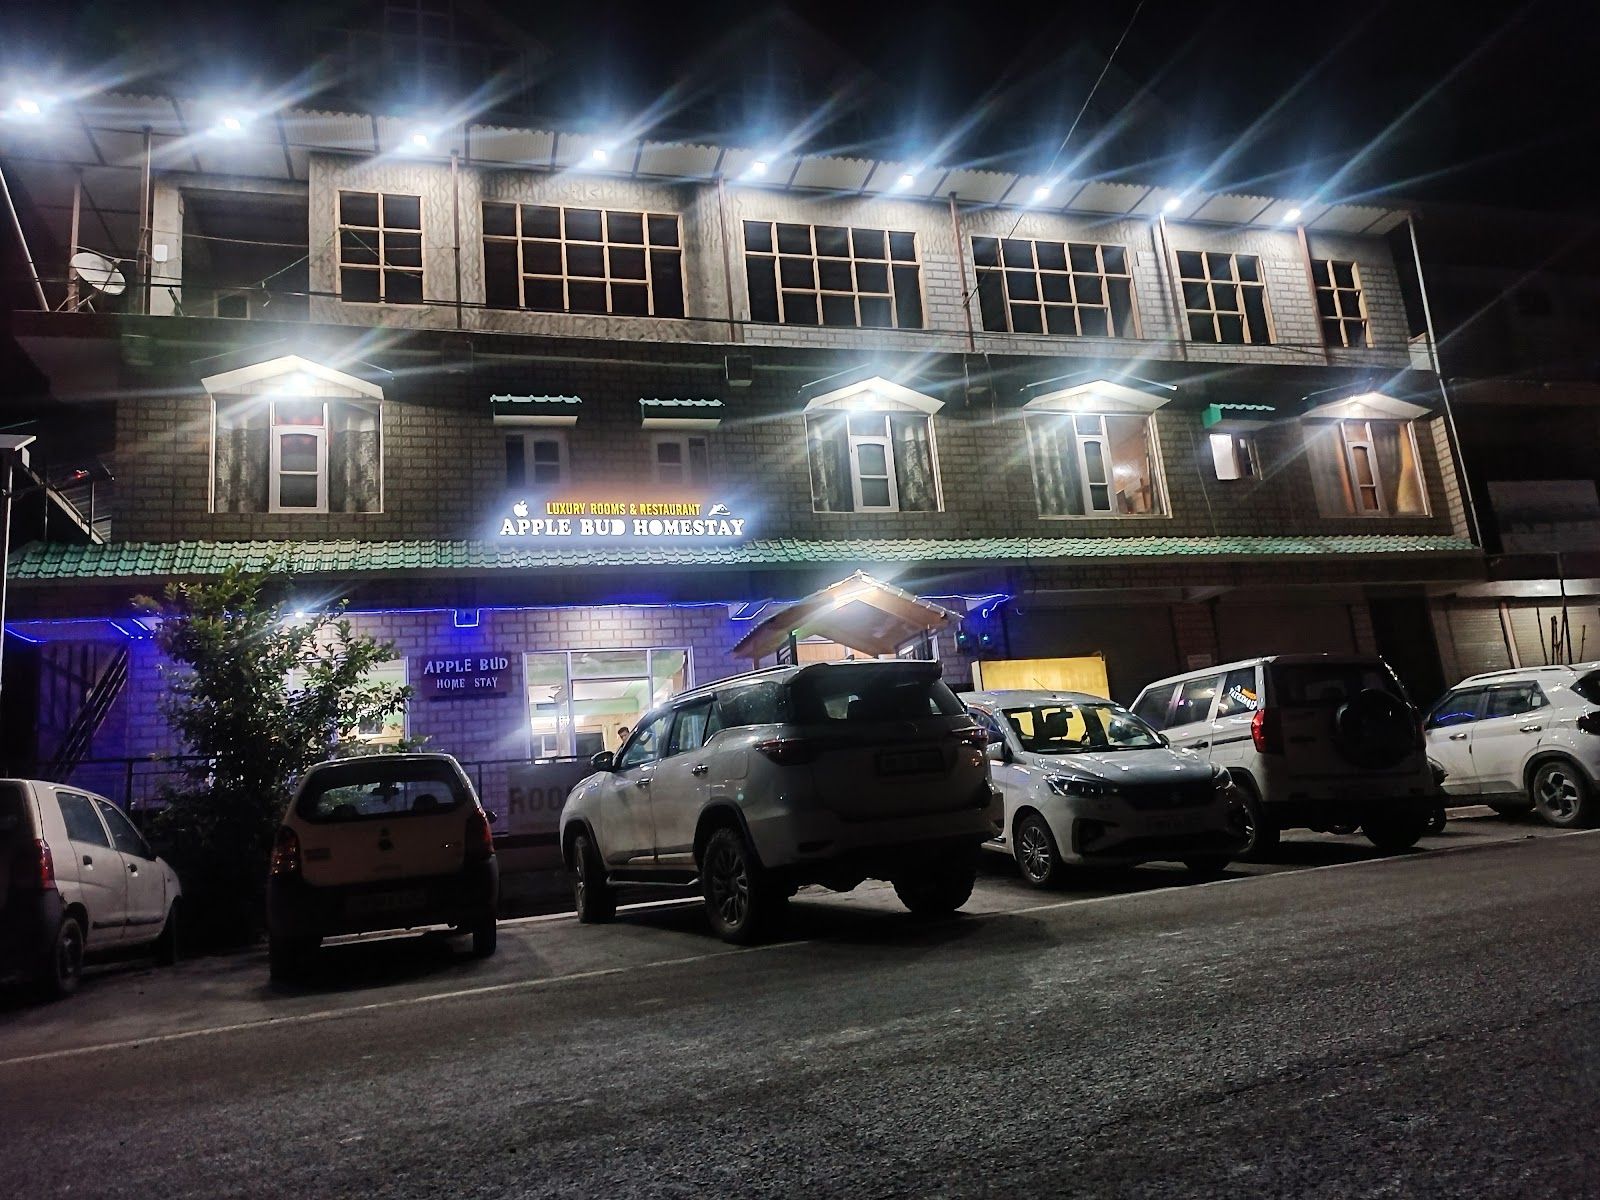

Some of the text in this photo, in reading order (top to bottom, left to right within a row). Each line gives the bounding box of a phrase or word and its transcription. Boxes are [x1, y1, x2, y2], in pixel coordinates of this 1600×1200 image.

[546, 502, 701, 516] LUXURY ROOMS & RESTAURANT
[500, 518, 746, 536] APPLE BUD HOMESTAY
[423, 656, 509, 675] APPLE BUD
[436, 676, 498, 690] HOME STAY
[509, 786, 562, 815] ROO
